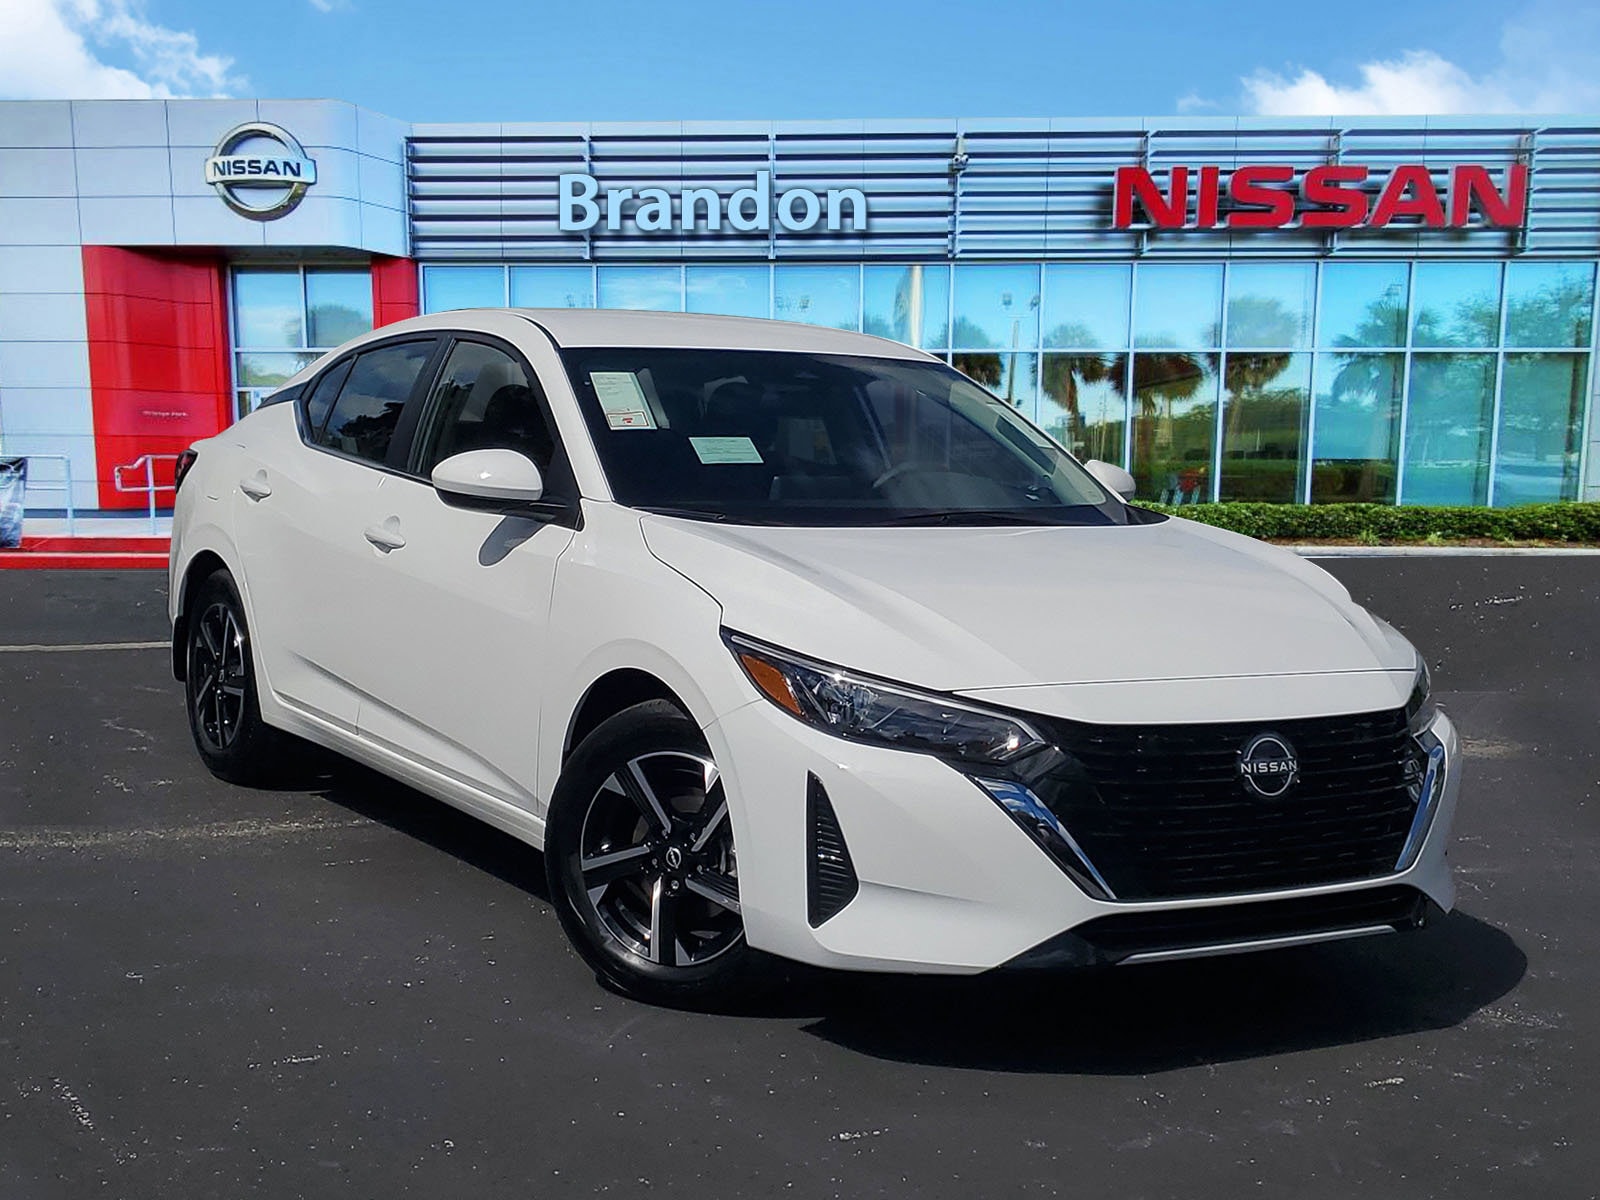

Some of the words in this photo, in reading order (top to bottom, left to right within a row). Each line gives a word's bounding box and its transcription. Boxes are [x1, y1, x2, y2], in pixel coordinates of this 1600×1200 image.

[213, 160, 301, 177] NISSAN
[559, 170, 867, 231] Brandon
[1113, 165, 1529, 229] NISSAN
[1240, 760, 1297, 774] NISSAN
